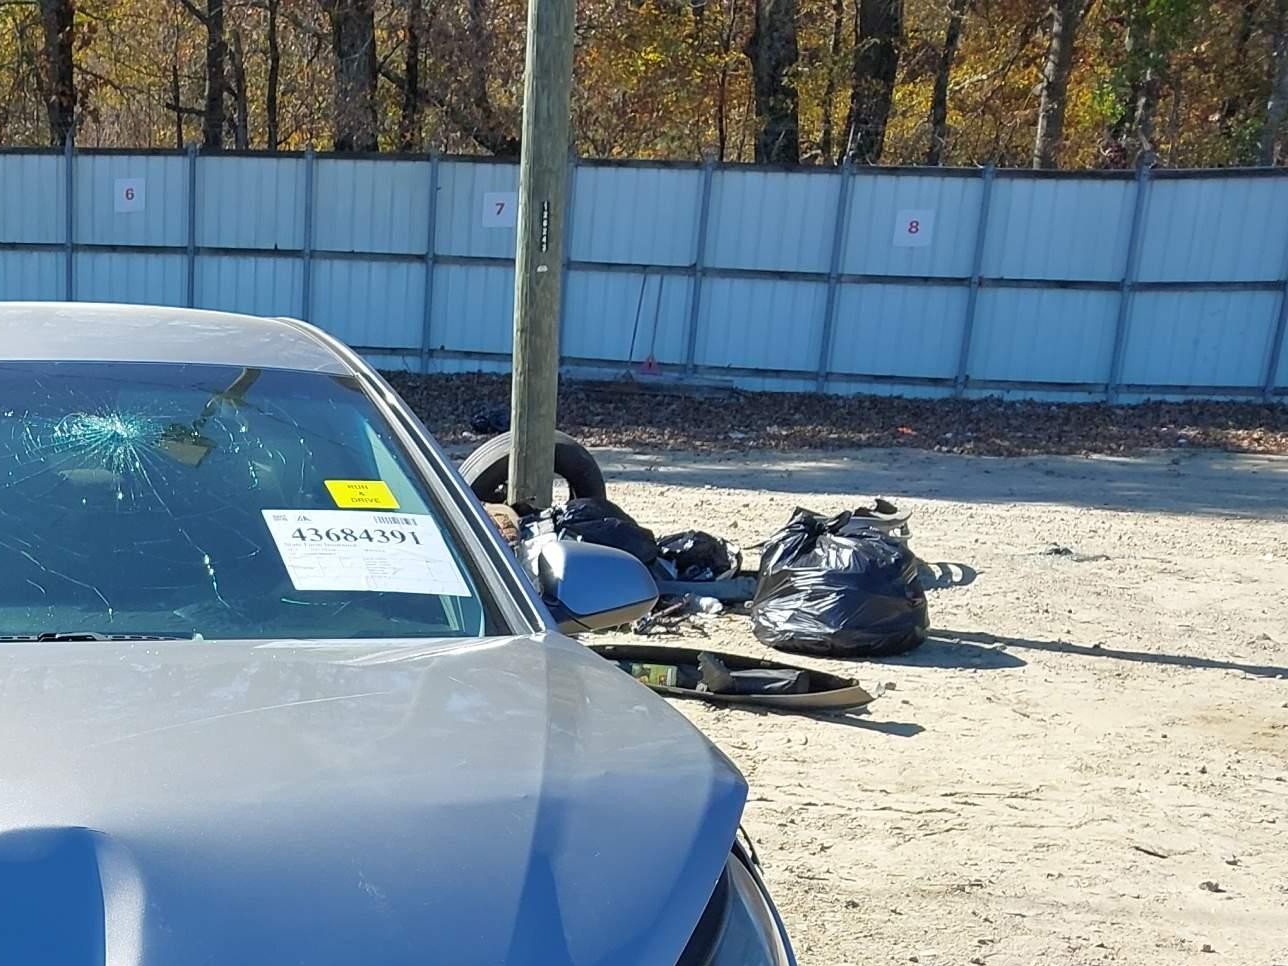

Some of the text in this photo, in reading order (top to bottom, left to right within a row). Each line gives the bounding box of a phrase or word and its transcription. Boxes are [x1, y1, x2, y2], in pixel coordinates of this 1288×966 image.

[125, 188, 135, 200] 6
[495, 203, 505, 216] 7
[908, 220, 920, 234] 8
[291, 527, 424, 546] 43684391
